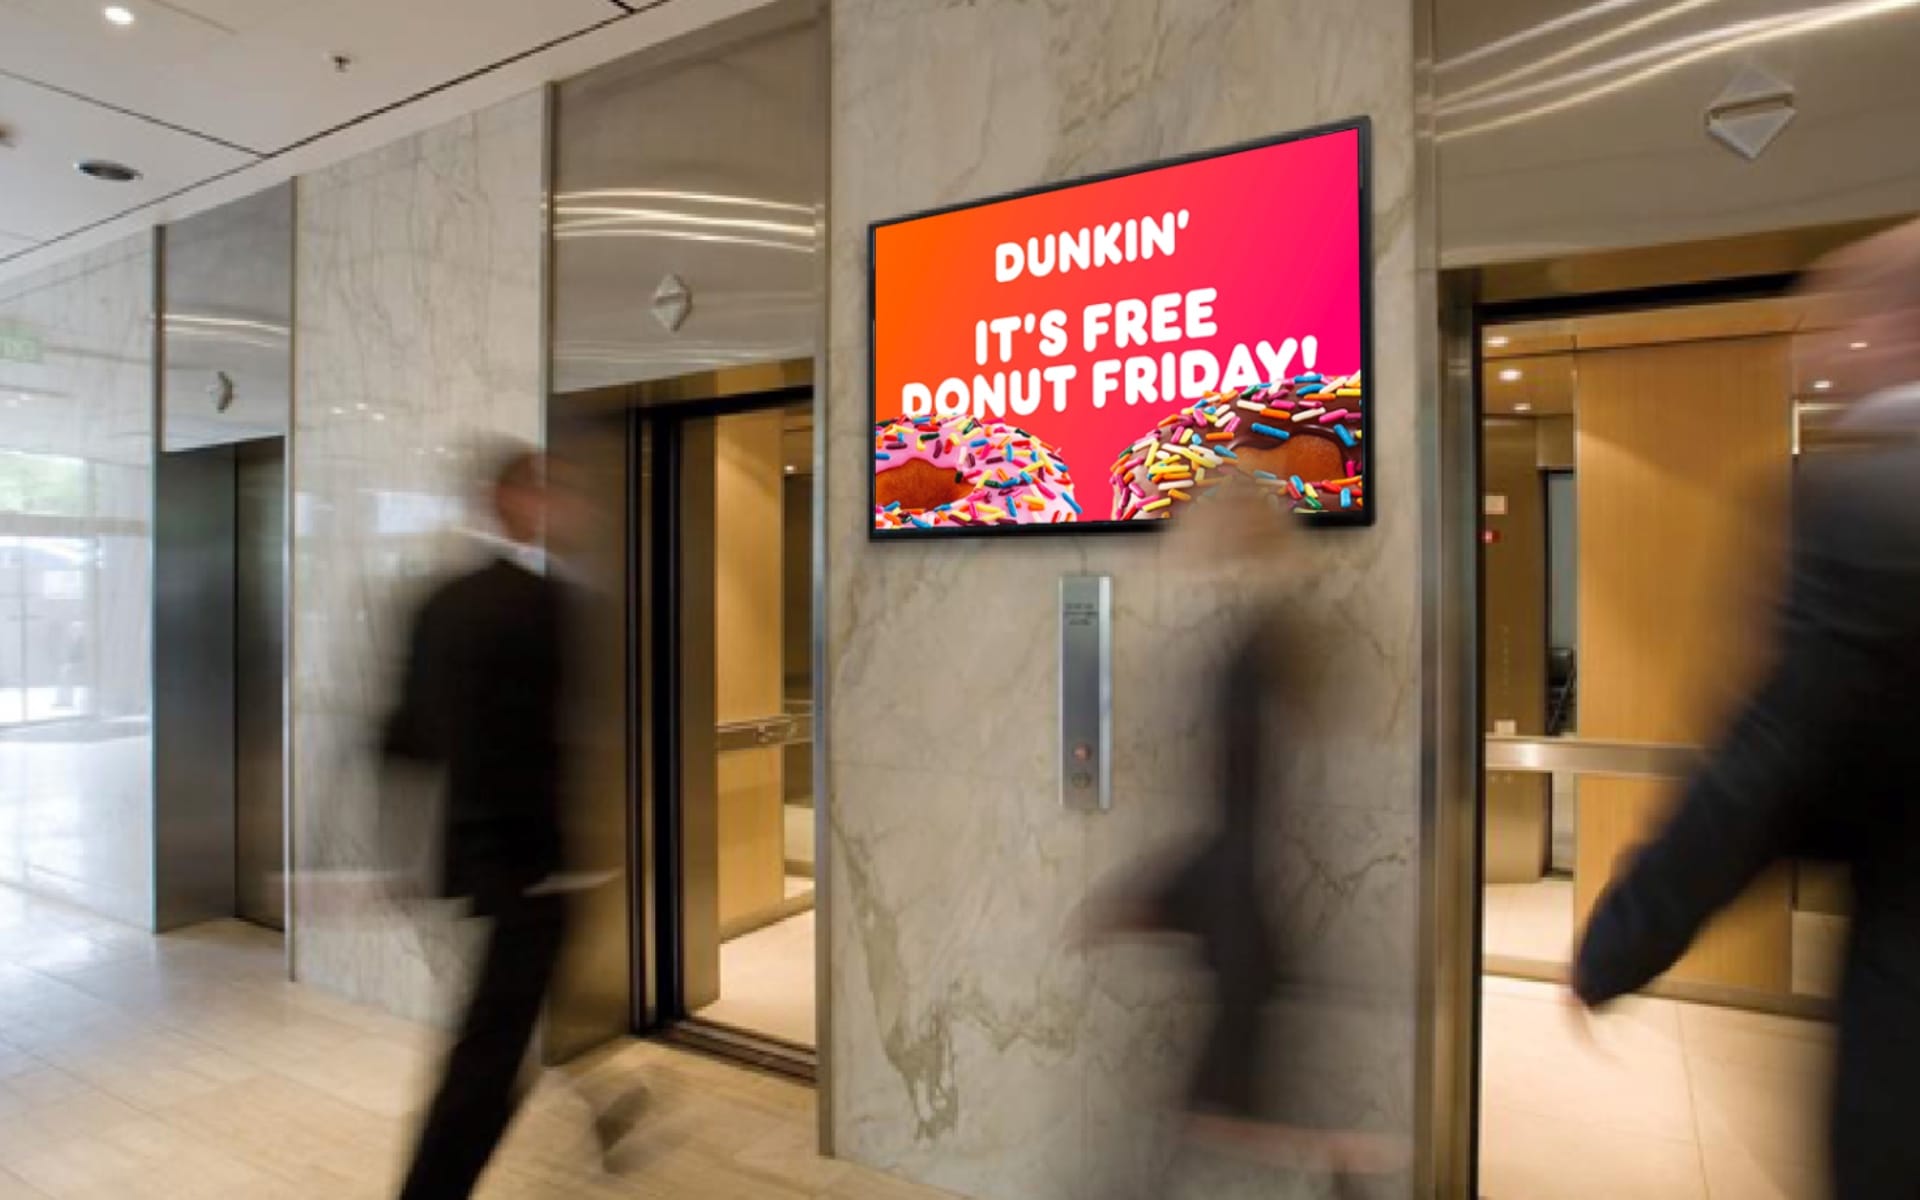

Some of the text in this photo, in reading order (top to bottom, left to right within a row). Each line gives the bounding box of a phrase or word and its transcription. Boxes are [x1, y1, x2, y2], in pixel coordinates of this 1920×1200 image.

[995, 209, 1190, 283] DUNKIN'
[974, 287, 1218, 366] IT'S FREE
[901, 335, 1318, 420] DONUT FRIDAY!
